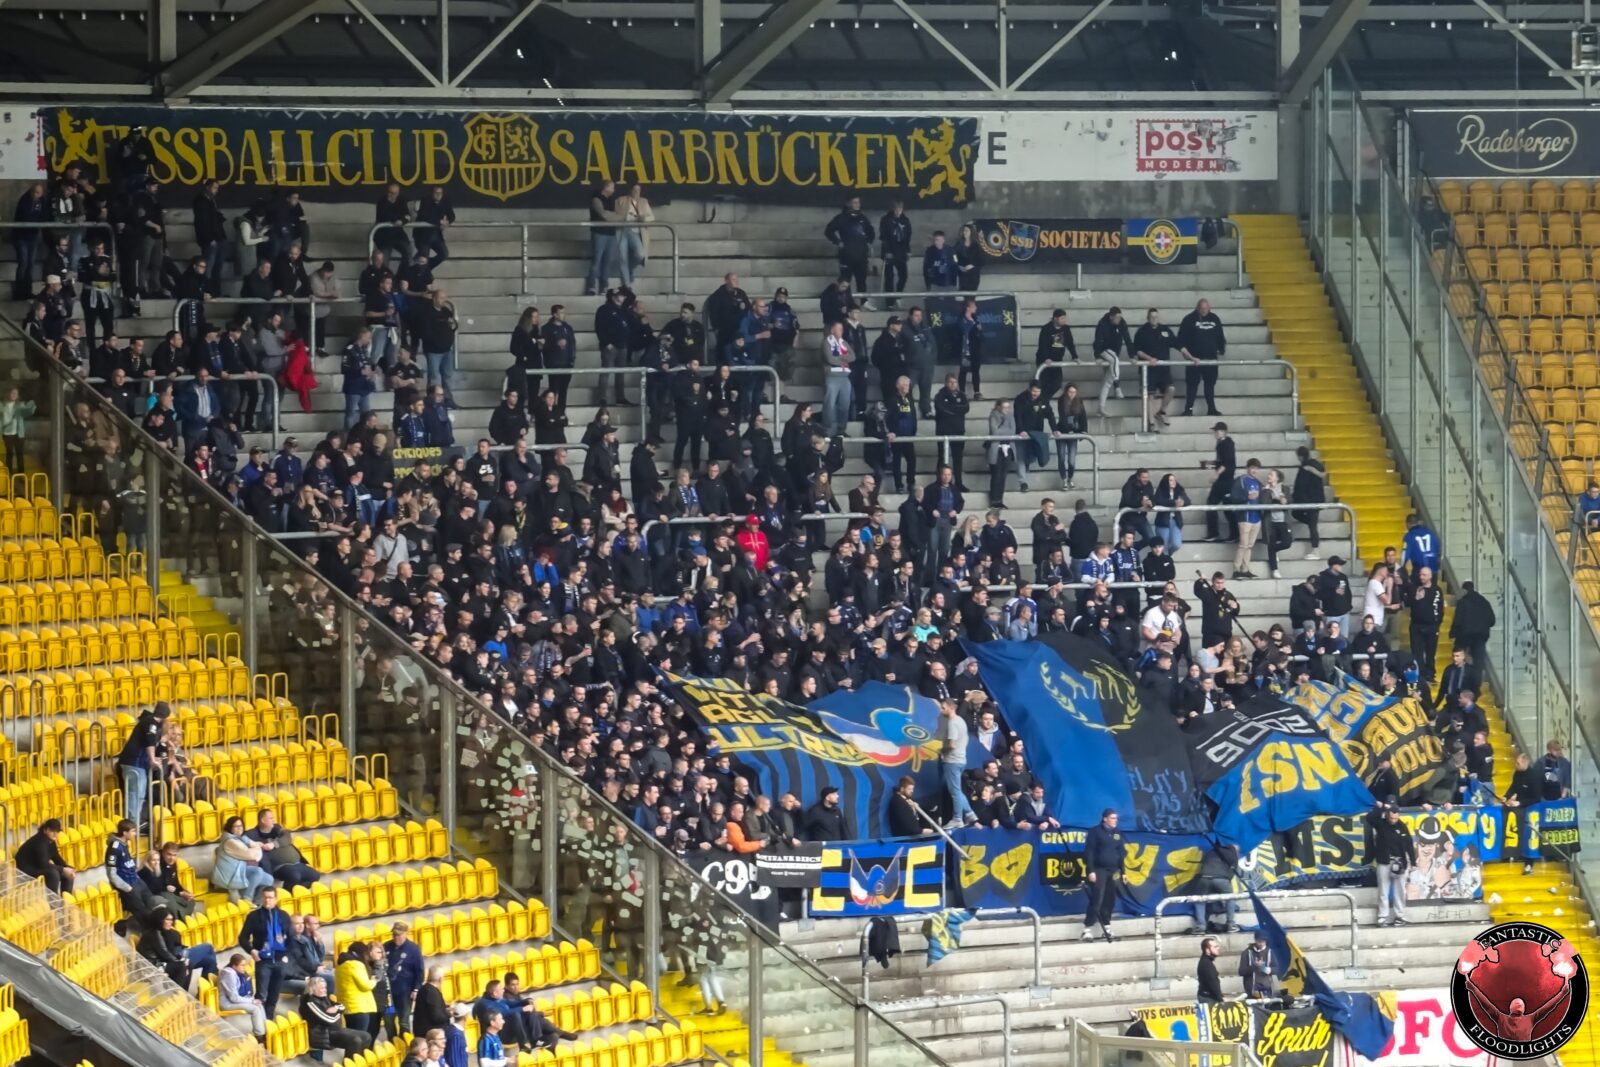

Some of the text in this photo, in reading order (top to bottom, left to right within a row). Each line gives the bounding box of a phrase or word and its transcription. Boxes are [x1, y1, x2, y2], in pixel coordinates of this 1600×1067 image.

[1145, 129, 1217, 157] post
[1456, 114, 1572, 161] Radeberger
[95, 125, 917, 188] FSSBALLCLUB SAARBRÜCKEN
[1145, 160, 1218, 169] MODERN
[1040, 230, 1121, 249] SOCIETAS
[1415, 533, 1431, 553] 17
[1257, 1012, 1332, 1056] Youth
